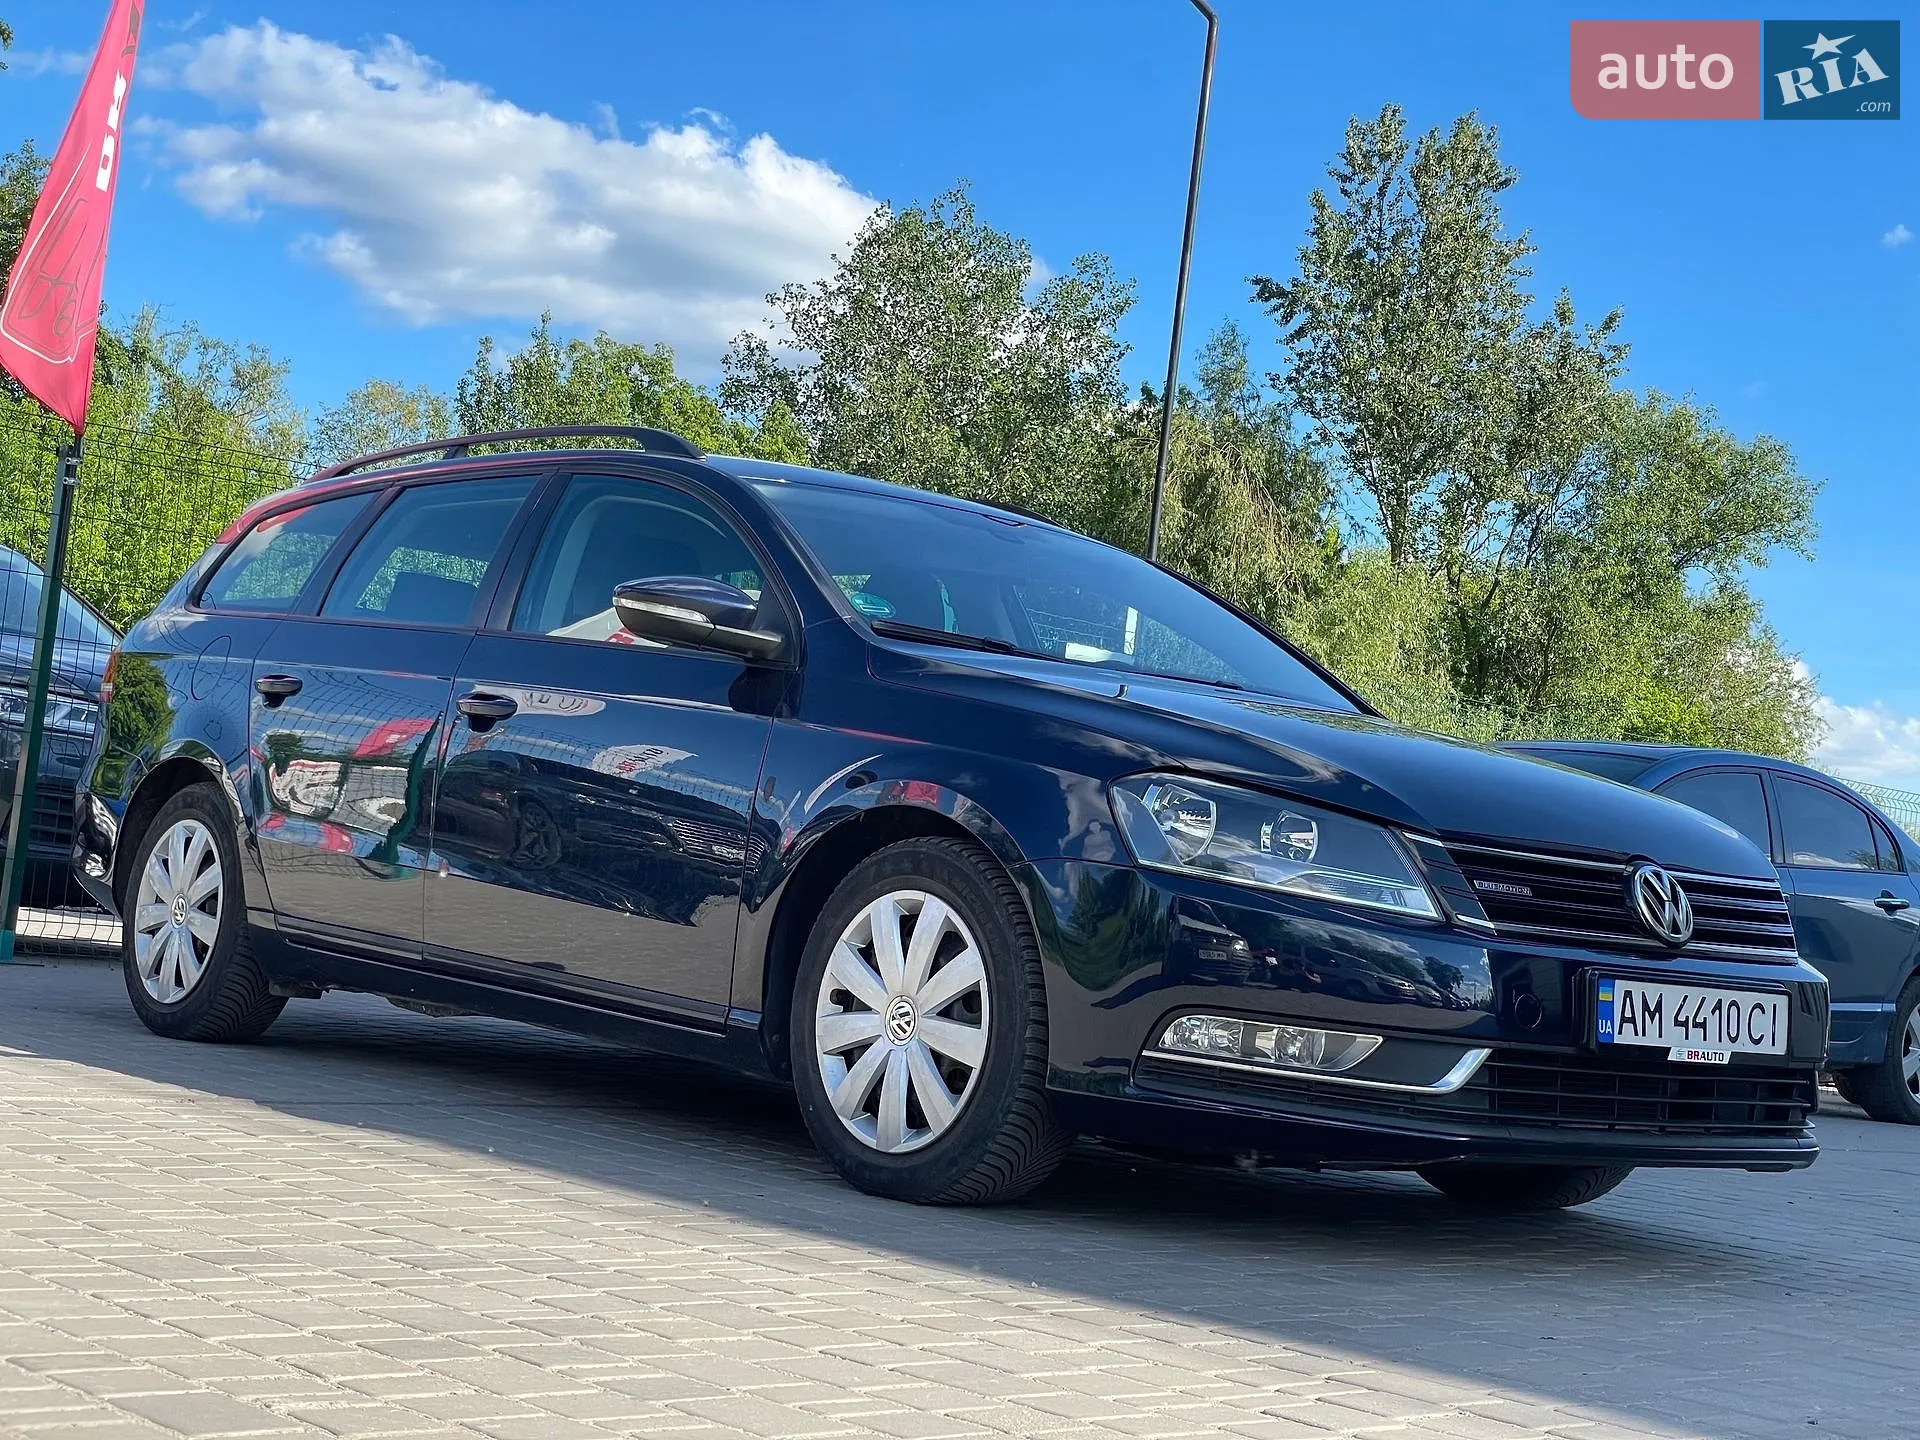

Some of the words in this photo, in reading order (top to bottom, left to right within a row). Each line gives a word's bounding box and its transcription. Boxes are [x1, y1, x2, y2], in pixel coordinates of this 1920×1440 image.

[1477, 880, 1531, 896] BLUEMOTION
[1598, 1018, 1613, 1034] UA
[1617, 989, 1663, 1039] AM
[1673, 994, 1741, 1044] 4410
[1747, 1002, 1777, 1047] CI
[1686, 1050, 1725, 1062] BRAUTO
